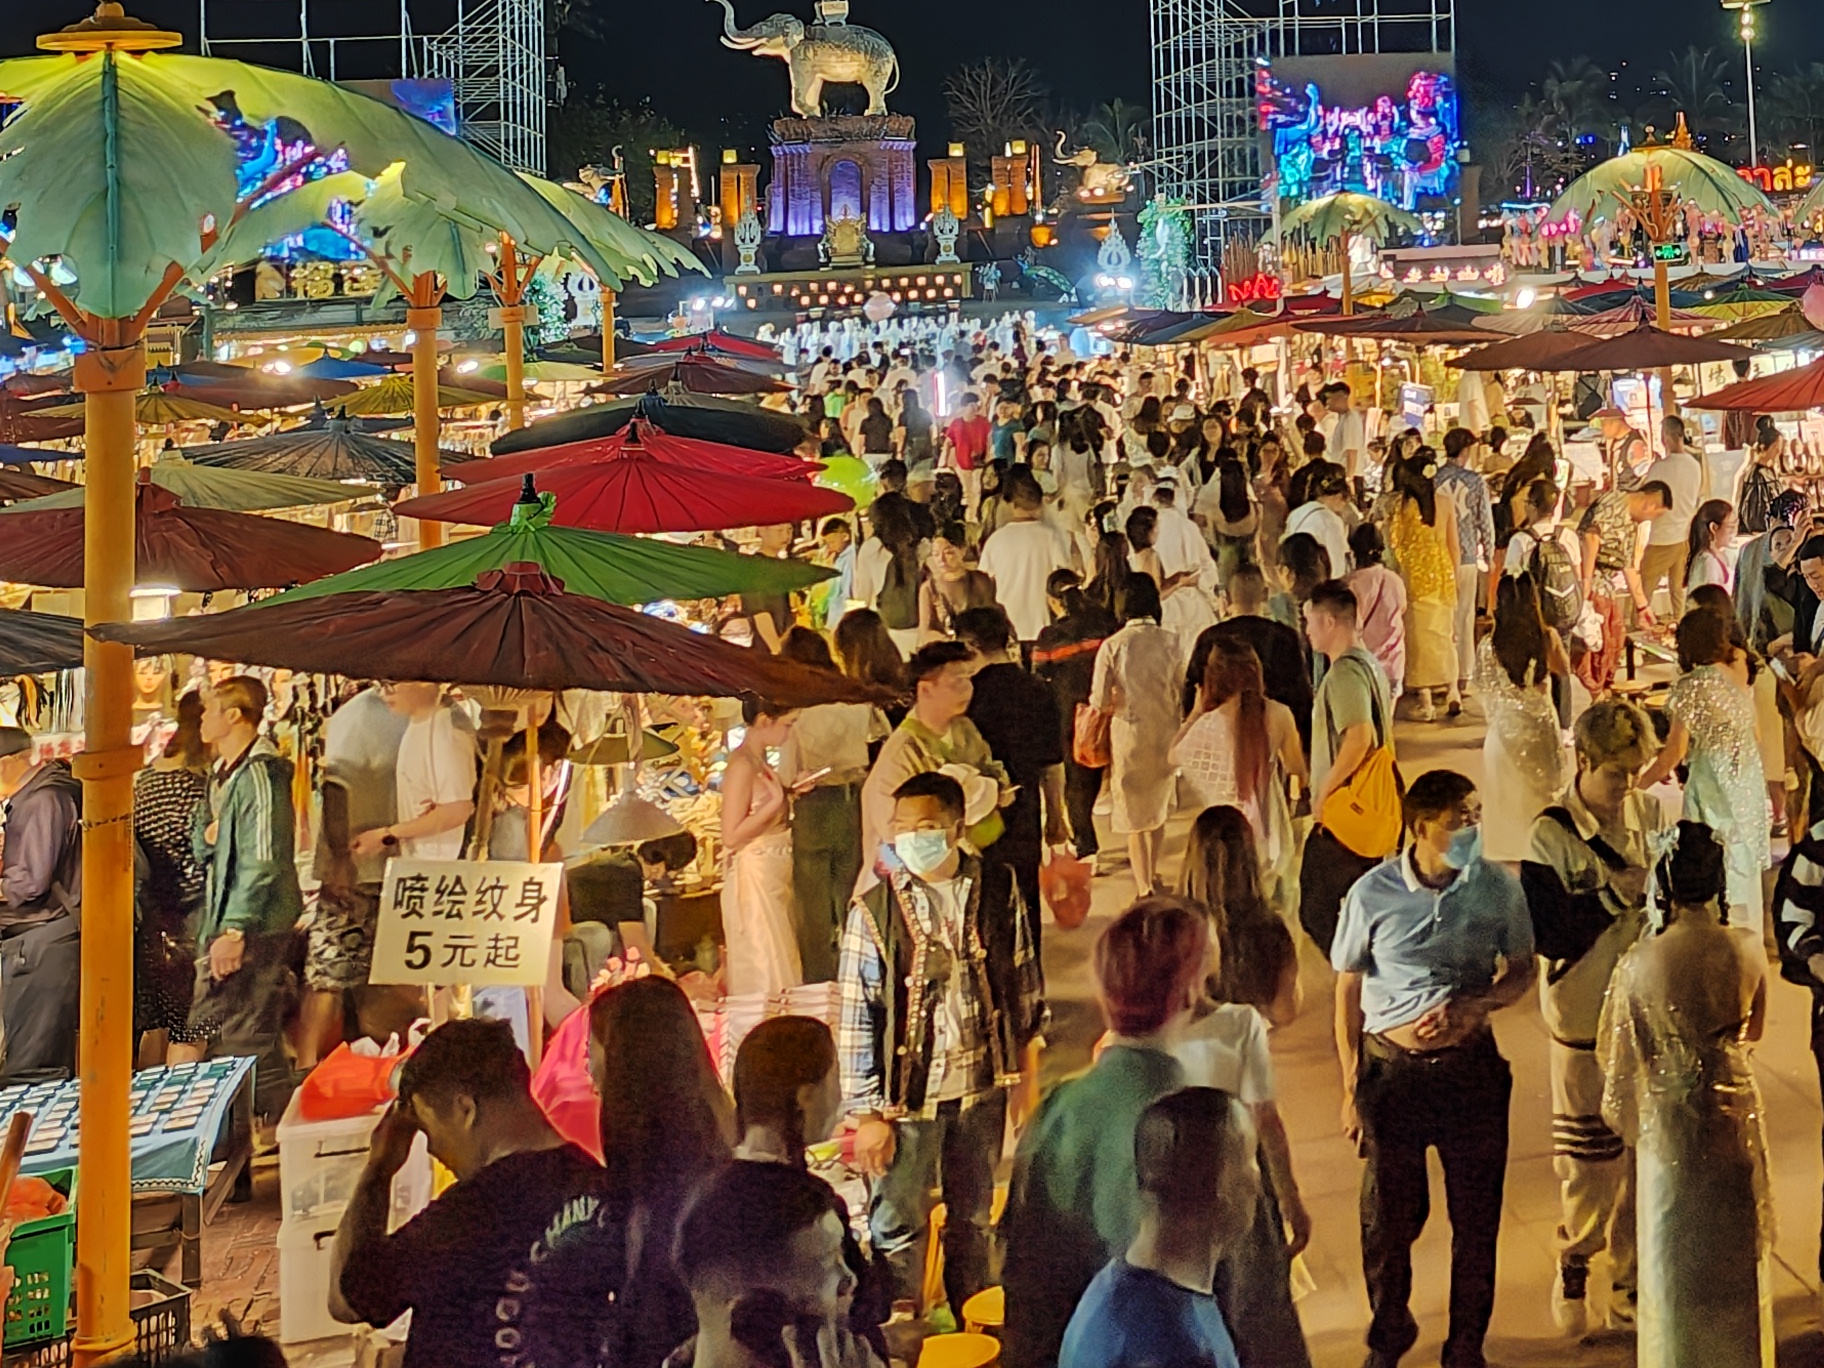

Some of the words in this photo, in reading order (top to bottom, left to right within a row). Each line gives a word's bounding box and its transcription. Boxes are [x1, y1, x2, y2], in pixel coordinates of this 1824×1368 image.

[393, 873, 549, 923] 喷绘纹身
[404, 931, 521, 970] 5元起
